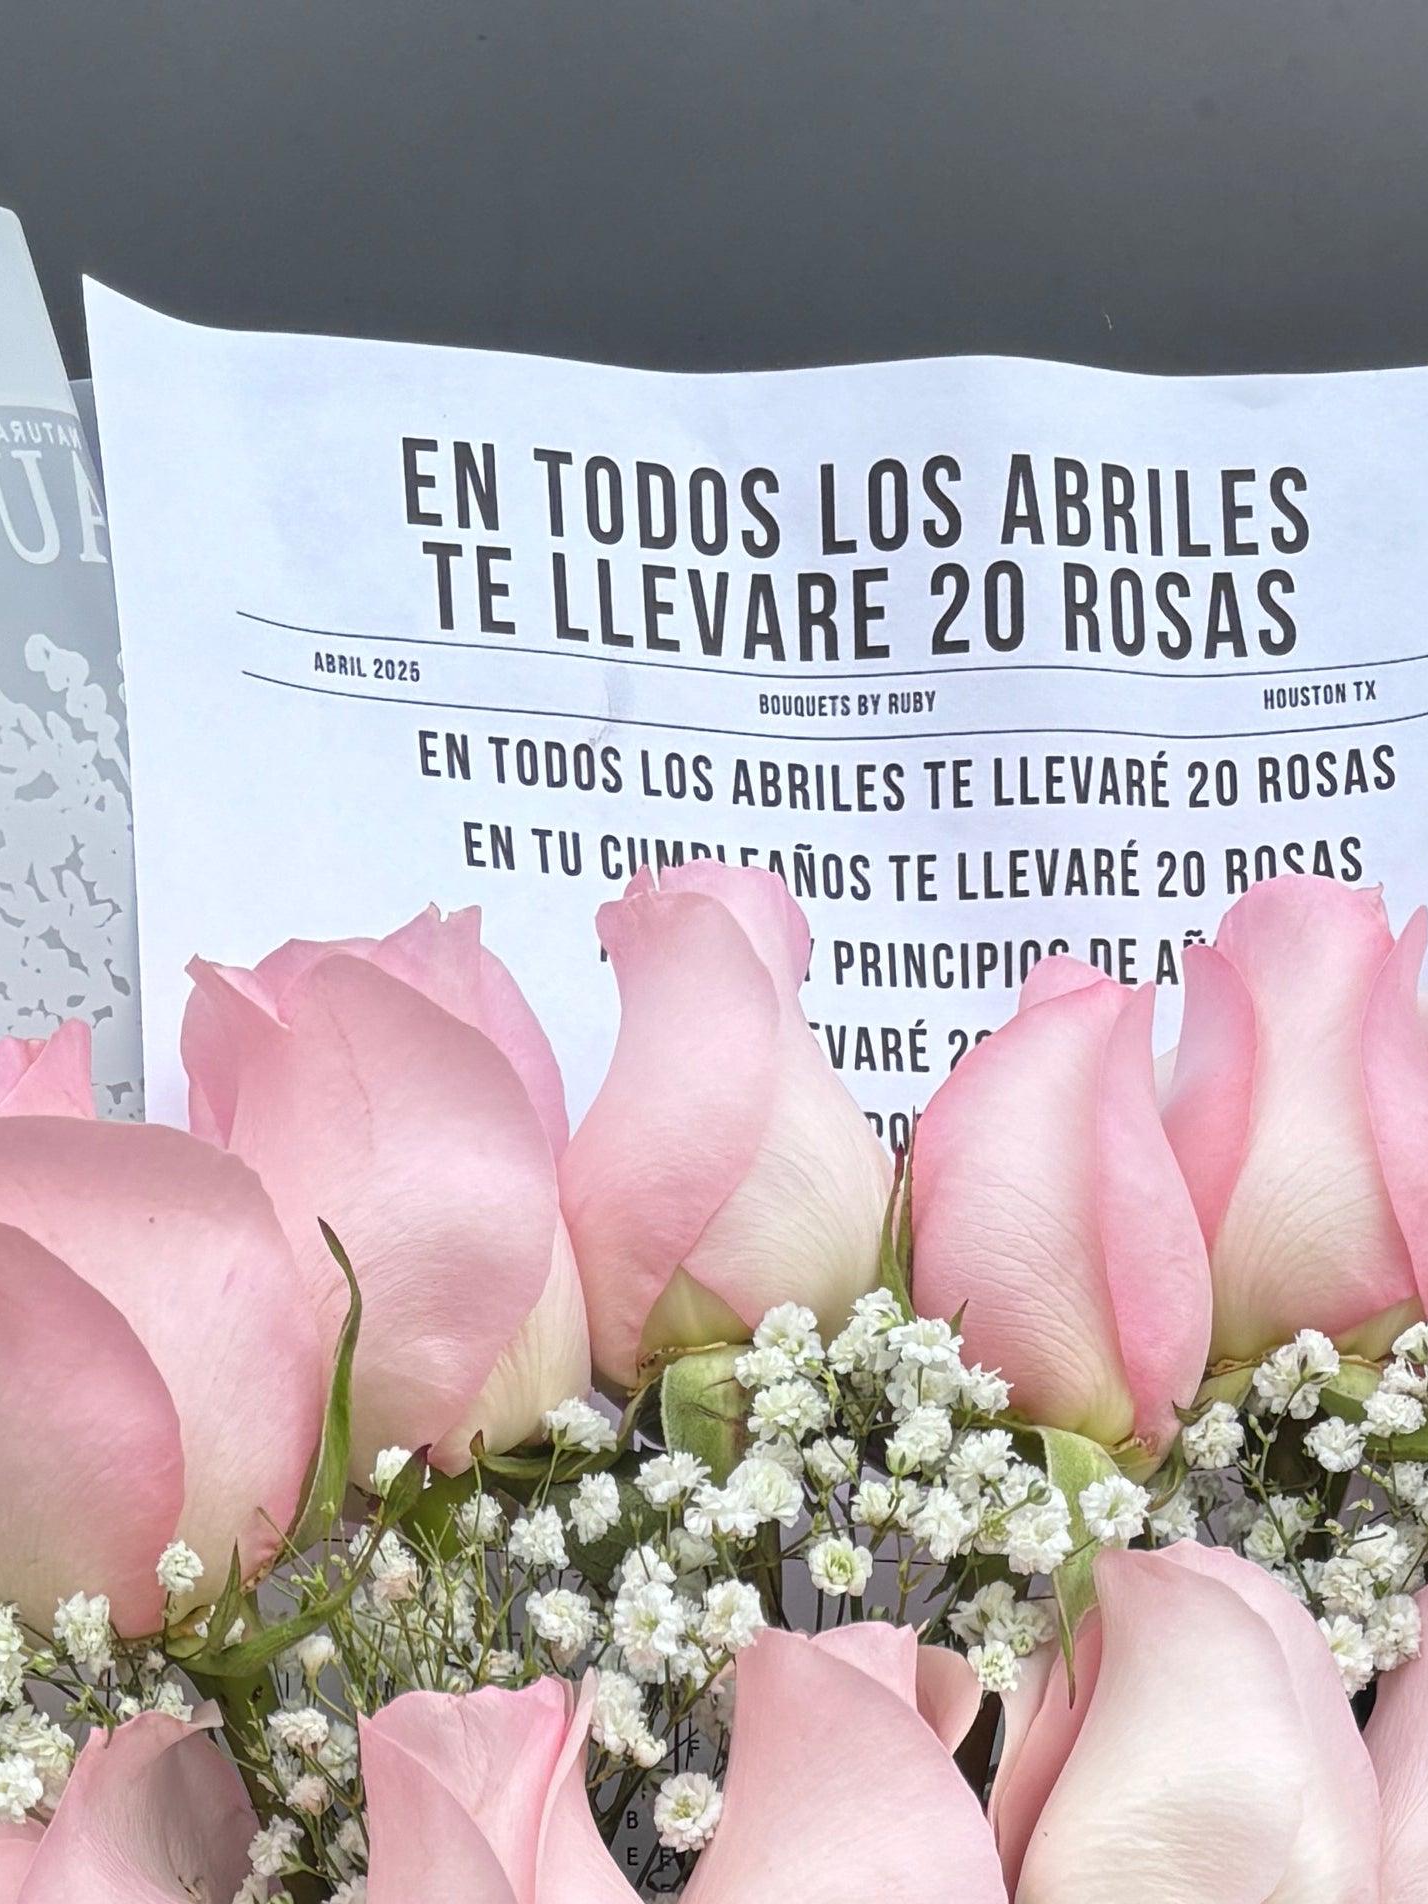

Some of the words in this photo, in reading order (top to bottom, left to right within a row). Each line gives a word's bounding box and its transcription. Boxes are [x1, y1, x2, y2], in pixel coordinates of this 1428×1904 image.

[401, 436, 501, 532] EN
[532, 446, 781, 560] TODOS
[819, 453, 963, 557] LOS
[999, 452, 1310, 558] ABRILES
[421, 540, 517, 636] TE
[551, 551, 891, 663] LLEVARE
[929, 558, 1026, 656] 20
[1062, 561, 1298, 661] ROSAS
[313, 650, 368, 679] ABRIL
[372, 657, 421, 683] 2025
[1262, 682, 1347, 711] HOUSTON
[1352, 678, 1377, 703] TX
[758, 692, 852, 718] BOUQUETS
[856, 693, 882, 717] BY
[887, 689, 937, 716] RUBY
[417, 729, 472, 782] EN
[486, 735, 624, 795] TODOS
[640, 749, 715, 803] LOS
[731, 758, 906, 813] ABRILES
[922, 758, 974, 811] TE
[992, 749, 1171, 809] LLEVARÉ
[1186, 758, 1239, 809] 20
[1257, 743, 1397, 805] ROSAS
[462, 820, 516, 872] EN
[530, 827, 583, 878] TU
[887, 853, 939, 903] TE
[957, 838, 1141, 902] LLEVARÉ
[1156, 849, 1206, 899] 20
[806, 1018, 930, 1073] VARÉ
